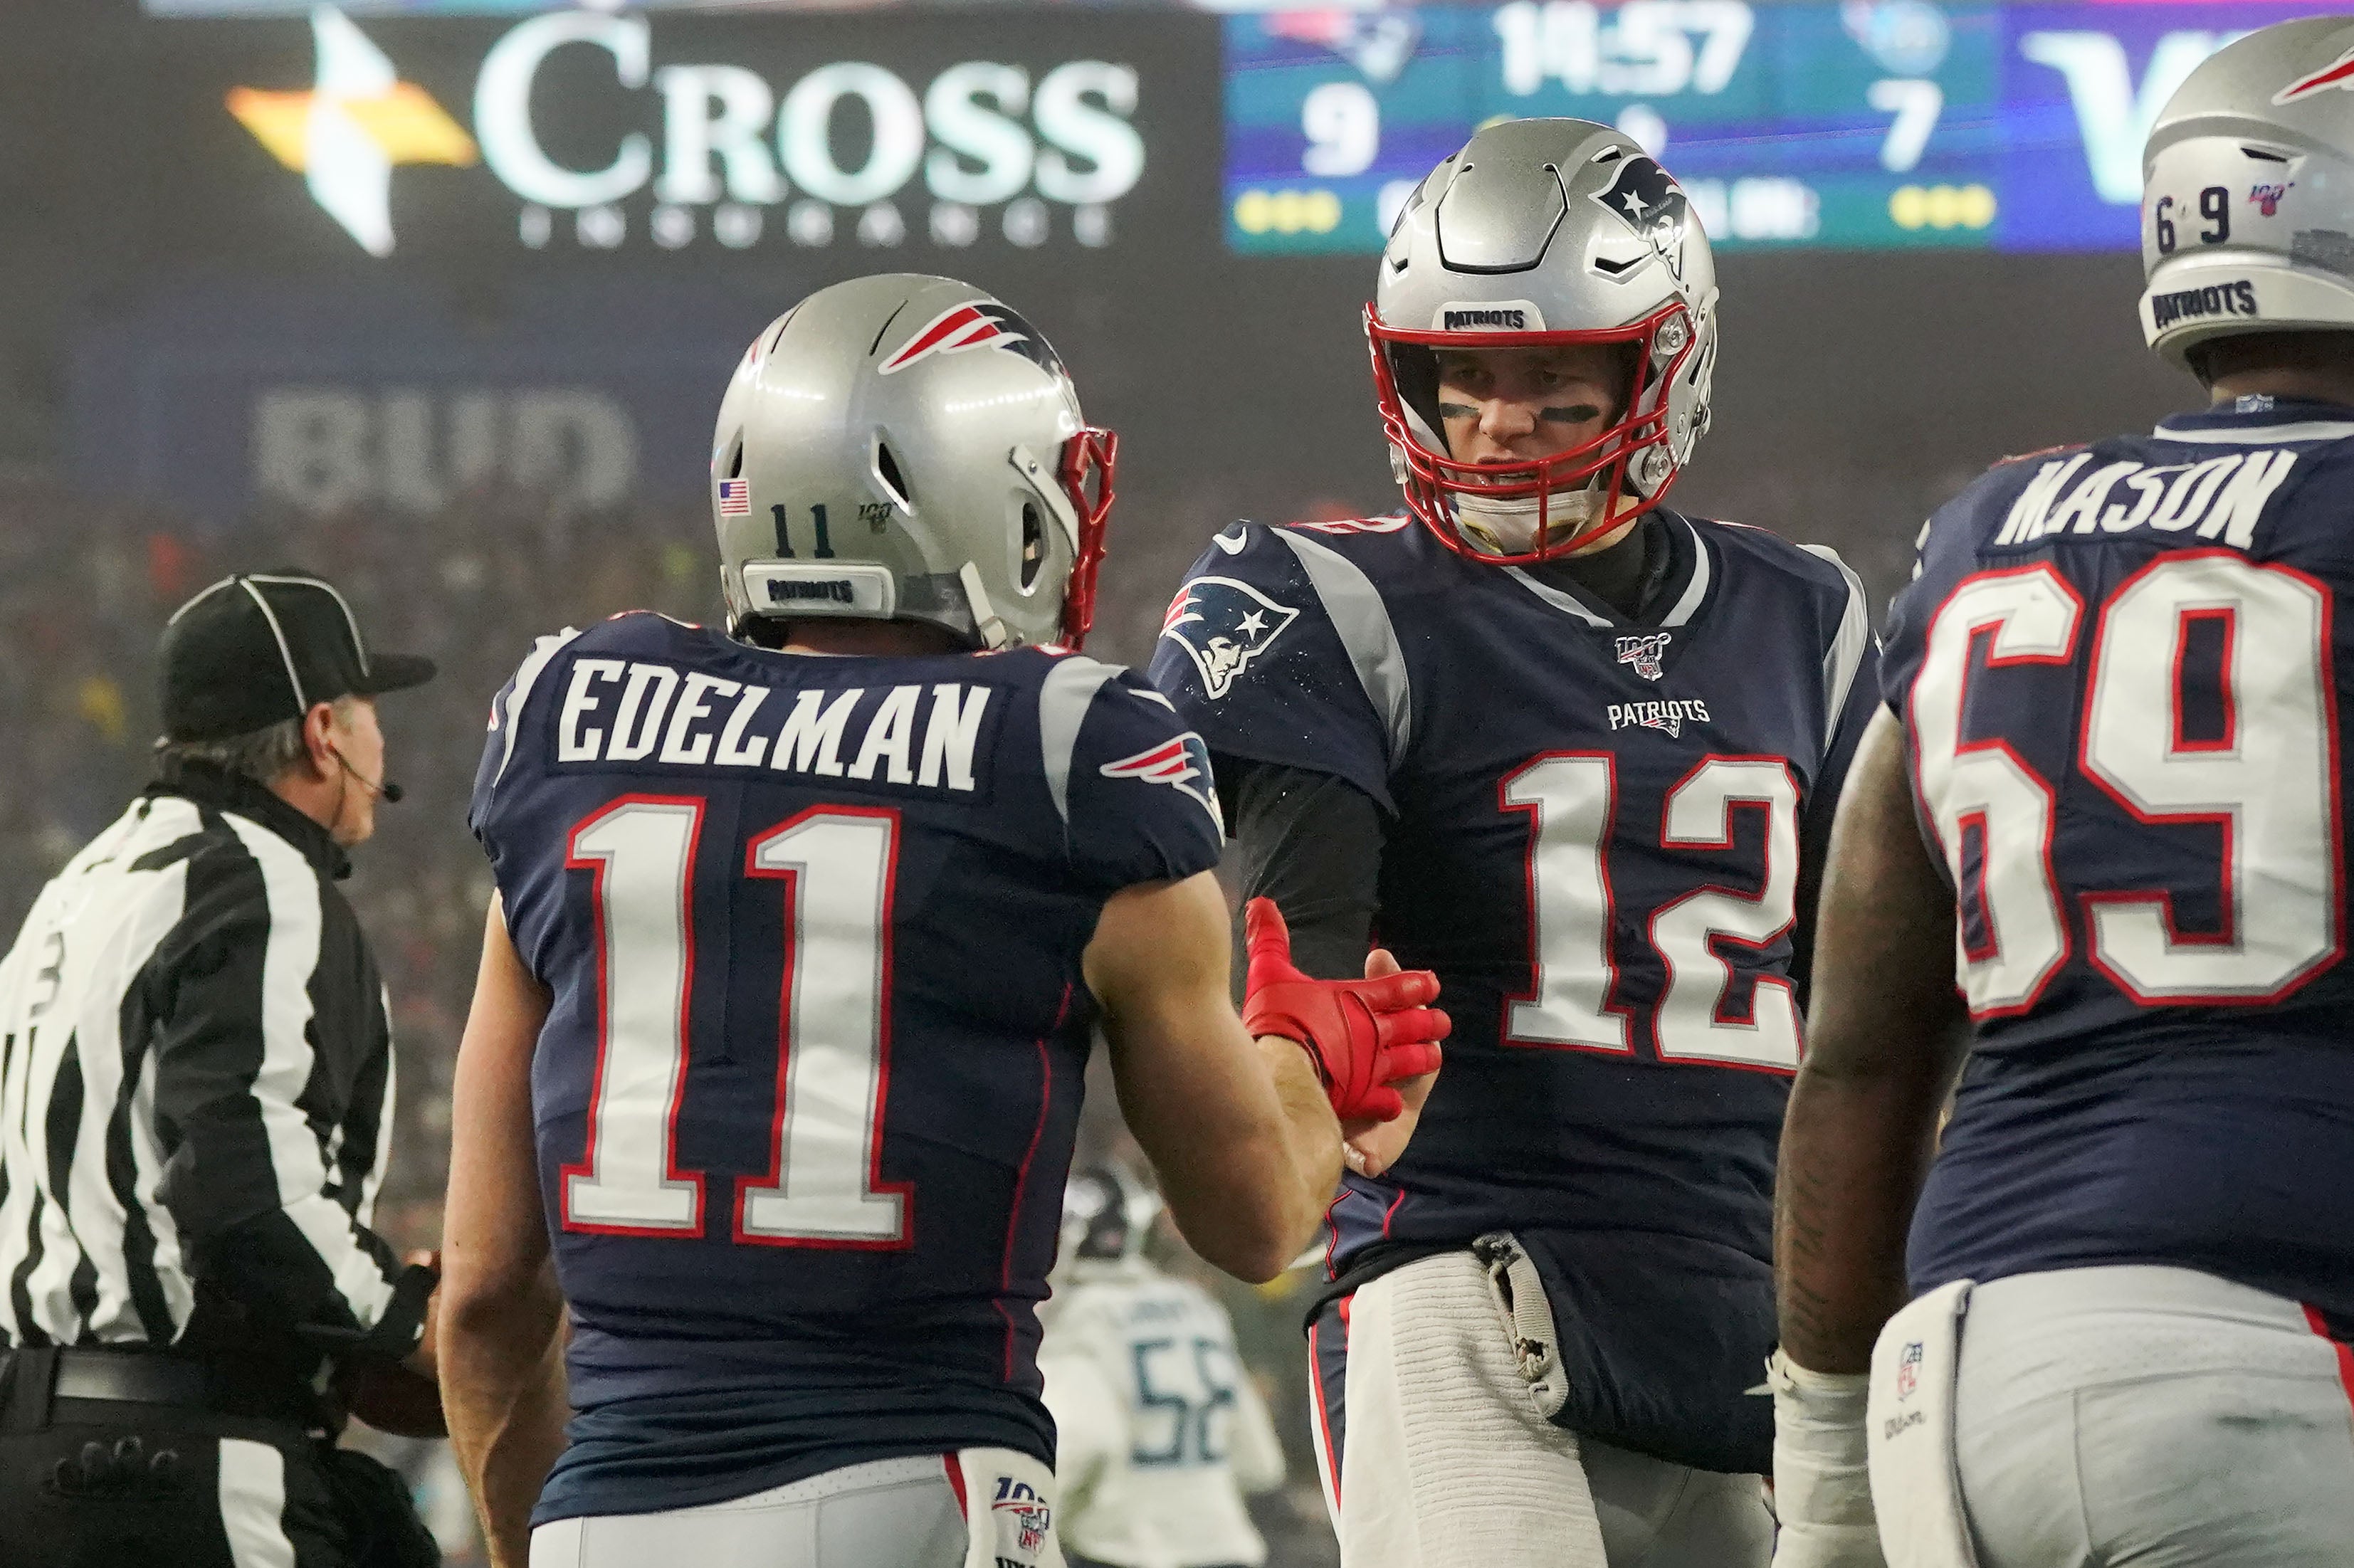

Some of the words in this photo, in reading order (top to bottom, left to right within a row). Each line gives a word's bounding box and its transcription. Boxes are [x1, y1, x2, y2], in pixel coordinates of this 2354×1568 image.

[473, 10, 1145, 208] CROSS
[1301, 81, 1380, 177] 9
[1866, 78, 1943, 172] 7
[2156, 186, 2231, 254] 69
[1444, 309, 1525, 330] PATRIOTS
[2152, 280, 2257, 330] PATRIOTS
[253, 384, 639, 512] BUD
[770, 503, 836, 559] 11
[1995, 448, 2298, 550] MASON
[558, 658, 992, 791] EDELMAN
[1607, 699, 1711, 731] PATRIOTS
[1908, 545, 2346, 1021] 69
[1498, 749, 1805, 1076] 12
[559, 792, 916, 1250] 11
